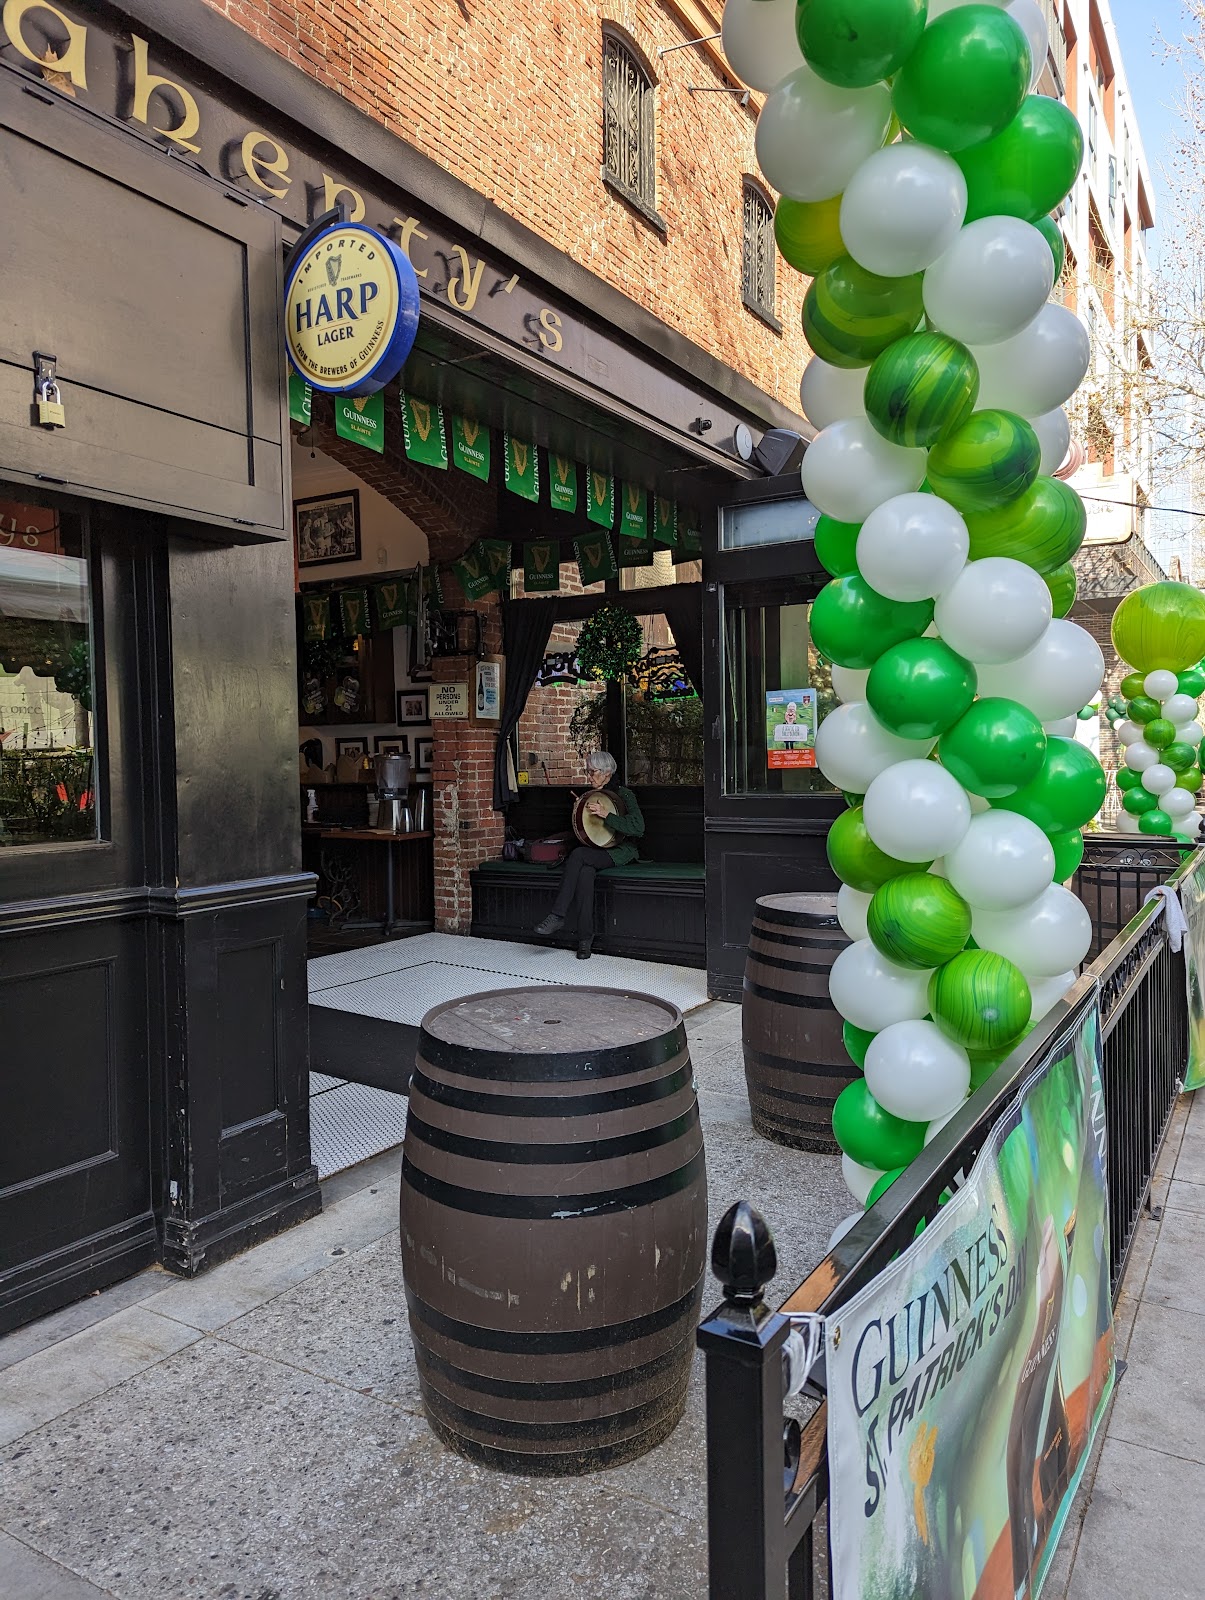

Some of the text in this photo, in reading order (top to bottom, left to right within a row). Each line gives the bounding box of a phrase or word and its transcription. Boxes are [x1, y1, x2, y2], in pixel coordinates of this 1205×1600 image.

[298, 239, 376, 284] IMPORTED
[295, 281, 379, 333] HARP
[317, 325, 355, 347] LAGER
[295, 319, 385, 376] FROM THE BREWERS OF GUINNESS
[343, 406, 378, 429] GUINNESS
[458, 441, 485, 462] GUINNESS
[623, 548, 649, 557] GUINNESS
[467, 575, 490, 590] GUINNESS
[528, 572, 554, 581] GUINNESS
[382, 608, 404, 619] GUINNESS
[441, 686, 456, 694] NO
[851, 1203, 1008, 1418] GUINNESS
[864, 1236, 1028, 1518] ST. PATRICK'S DAY
